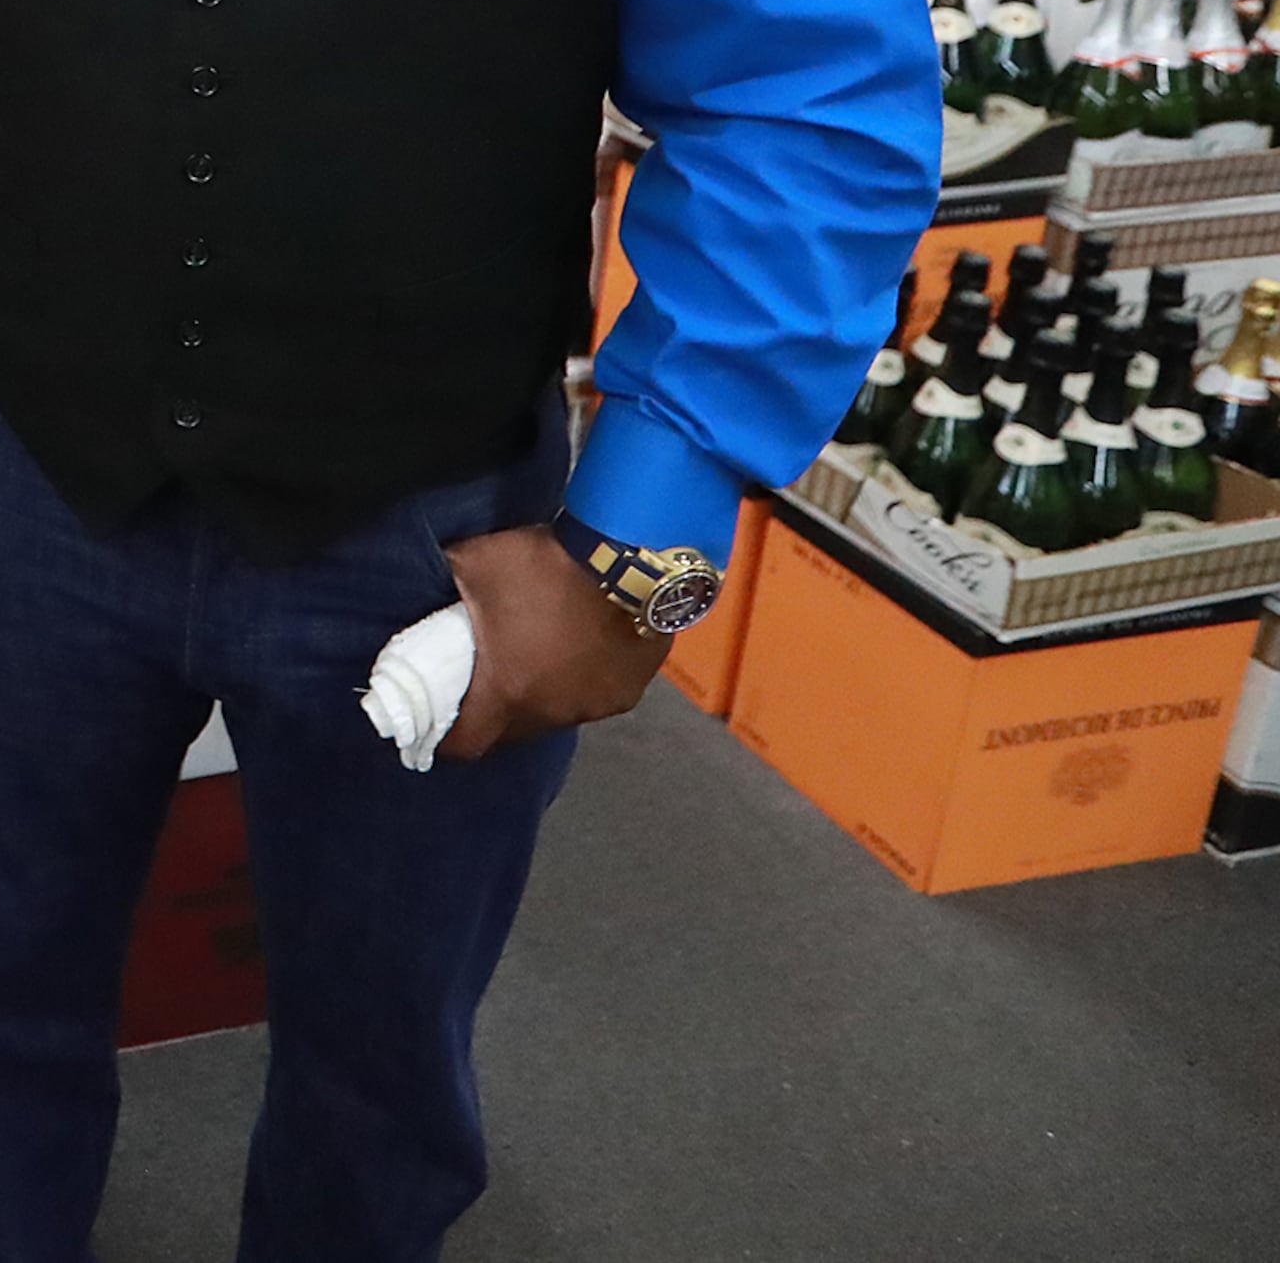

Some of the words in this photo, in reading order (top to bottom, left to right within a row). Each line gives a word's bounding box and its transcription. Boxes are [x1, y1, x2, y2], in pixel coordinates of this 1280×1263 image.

[1116, 707, 1146, 731] DE
[1148, 695, 1222, 725] PRINCE
[981, 713, 1114, 752] RICHEMONT
